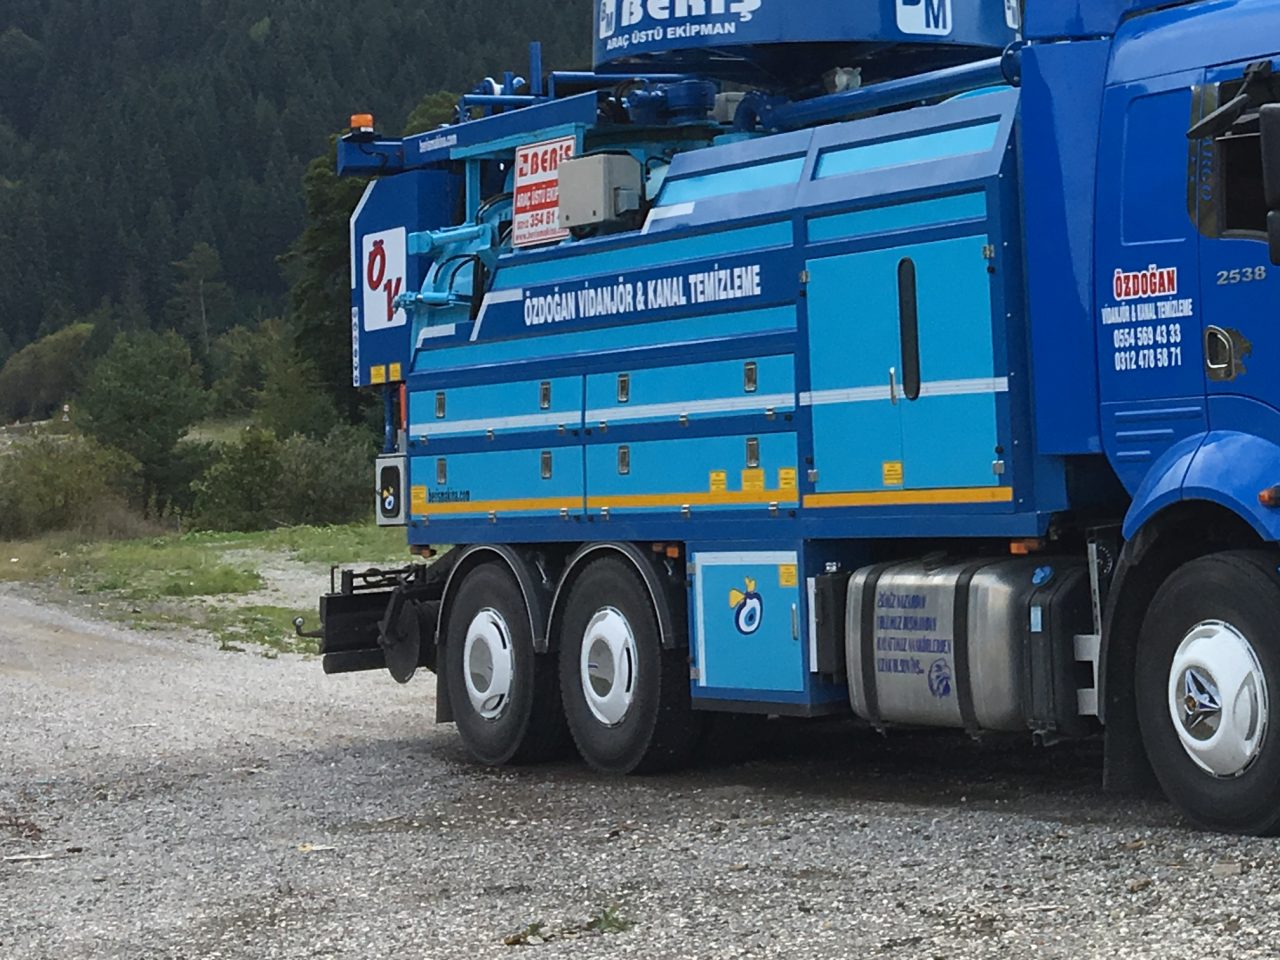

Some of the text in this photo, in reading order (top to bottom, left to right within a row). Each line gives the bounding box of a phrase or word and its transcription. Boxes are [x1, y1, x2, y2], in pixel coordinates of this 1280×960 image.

[606, 22, 736, 51] ARAÇ ÜSTÜ EKİPMAN
[1114, 265, 1177, 300] ÖZDOĞAN
[1216, 265, 1267, 285] 2538
[524, 263, 761, 326] ÖZDOĞAN VİDANJÖR & KANAL TEMİZLEME
[1113, 327, 1135, 348] 0554
[1155, 324, 1167, 345] 43
[1168, 323, 1181, 344] 33
[1114, 350, 1136, 371] 0312
[1170, 346, 1182, 367] 71
